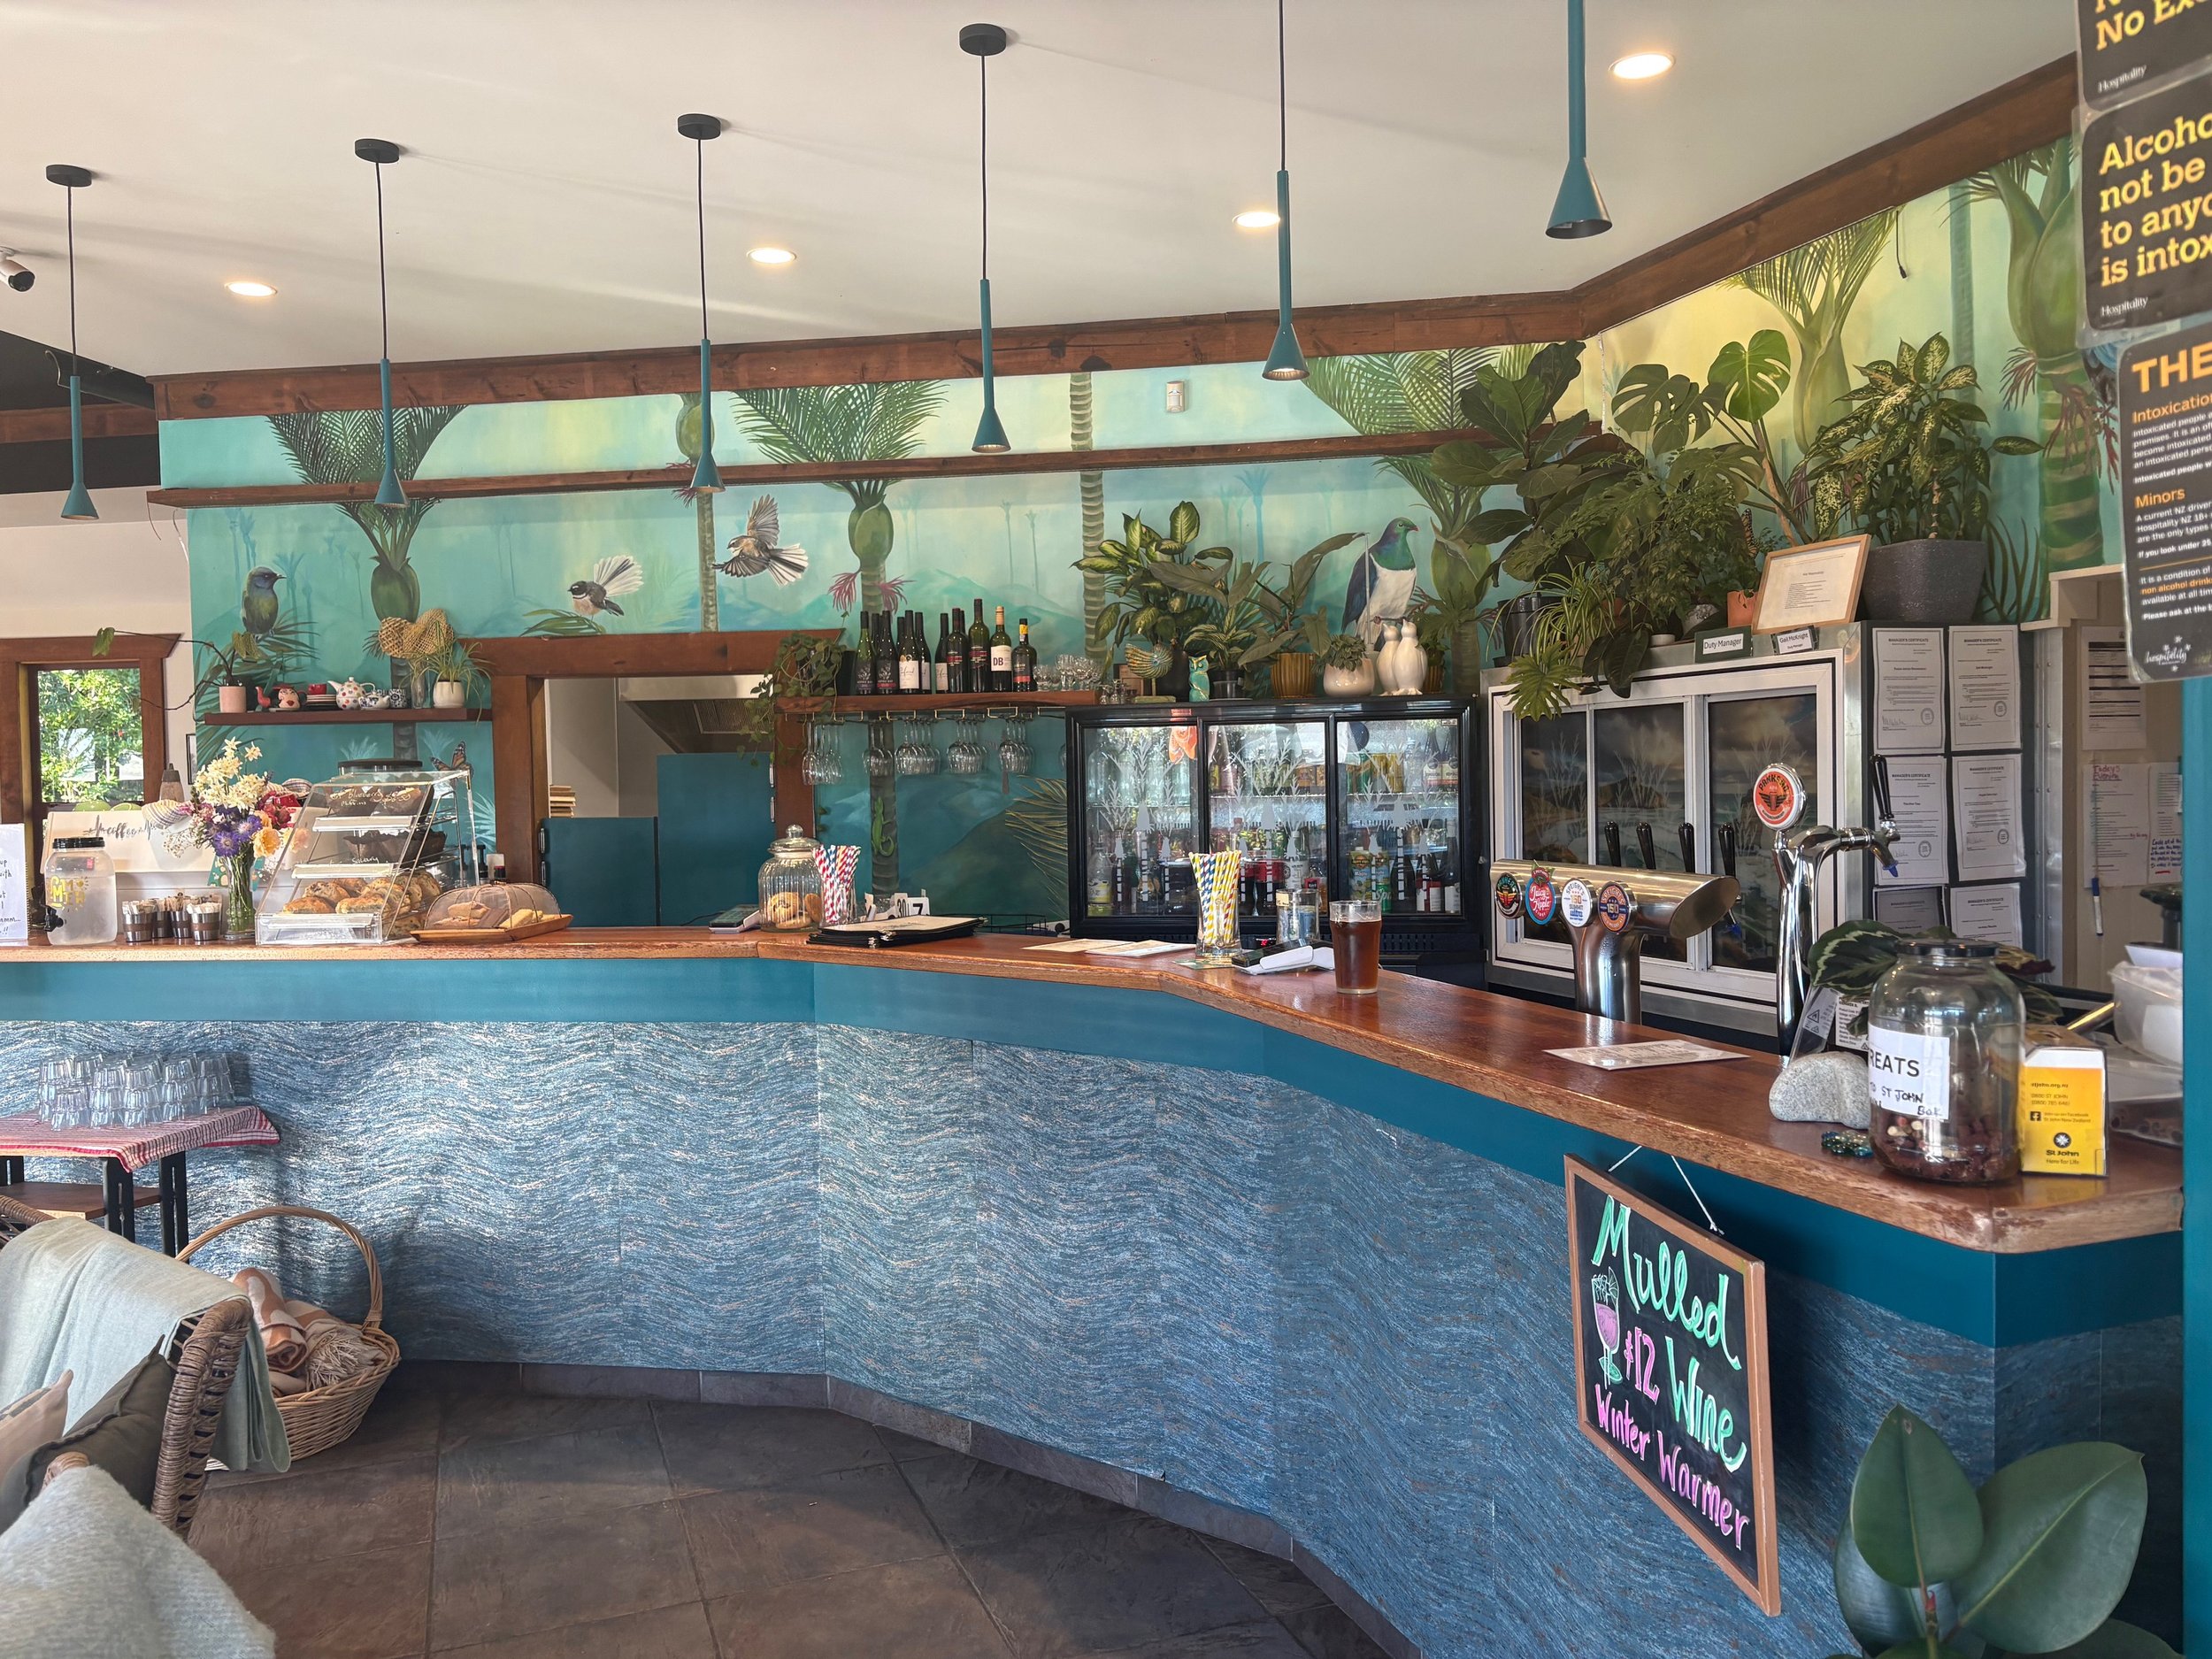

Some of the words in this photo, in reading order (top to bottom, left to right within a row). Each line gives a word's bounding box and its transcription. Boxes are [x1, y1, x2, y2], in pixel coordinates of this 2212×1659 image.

[2096, 11, 2145, 50] No
[2154, 0, 2208, 25] Ex
[2098, 65, 2147, 93] Hospitality
[2100, 168, 2154, 212] not
[2162, 157, 2206, 193] be
[2101, 220, 2133, 249] to
[2101, 257, 2129, 287] is
[2101, 296, 2148, 318] Hospitality
[2131, 342, 2212, 394] THE
[2132, 394, 2212, 424] Intoxicatio
[2133, 419, 2177, 437] Intoxicated
[2178, 411, 2207, 428] people
[2133, 433, 2172, 449] premises.
[2173, 428, 2179, 438] It
[2181, 427, 2189, 436] is
[2133, 445, 2165, 458] become
[2167, 433, 2211, 450] intoxicated
[2133, 461, 2144, 470] an
[2145, 449, 2190, 466] intoxicated
[2134, 467, 2177, 484] Intoxicated
[2177, 461, 2204, 476] people
[2135, 488, 2185, 509] Minors
[2144, 508, 2173, 520] current
[2175, 505, 2186, 515] NZ
[2137, 518, 2179, 533] Hospitality
[2181, 515, 2193, 524] NZ
[2138, 534, 2151, 543] are
[2152, 532, 2166, 541] the
[2167, 528, 2185, 538] only
[2185, 524, 2209, 535] types
[2145, 549, 2159, 558] you
[2160, 544, 2177, 555] look
[2177, 541, 2200, 551] under
[2140, 576, 2147, 585] It
[2148, 574, 2155, 583] is
[2163, 568, 2201, 581] condition
[2202, 565, 2211, 574] of
[2141, 587, 2157, 595] non
[2158, 580, 2188, 593] alcohol
[2142, 594, 2177, 606] available
[2177, 591, 2187, 600] at
[2188, 588, 2199, 599] all
[2143, 610, 2168, 621] Please
[2169, 607, 2183, 617] ask
[2184, 604, 2193, 615] at
[2194, 603, 2208, 613] the
[1704, 641, 1717, 649] Duty
[1717, 638, 1742, 649] Manager
[1779, 635, 1788, 644] Gail
[993, 657, 1004, 666] DB
[2145, 648, 2187, 665] hospitality
[912, 902, 923, 916] 7
[1607, 903, 1619, 914] 150
[1894, 1089, 1924, 1104] JOHN
[1591, 1194, 1742, 1371] Mulled
[1624, 1326, 1660, 1405] $12
[1665, 1335, 1747, 1472] Wine
[1595, 1383, 1650, 1461] Winter
[1657, 1429, 1750, 1551] Warmer
